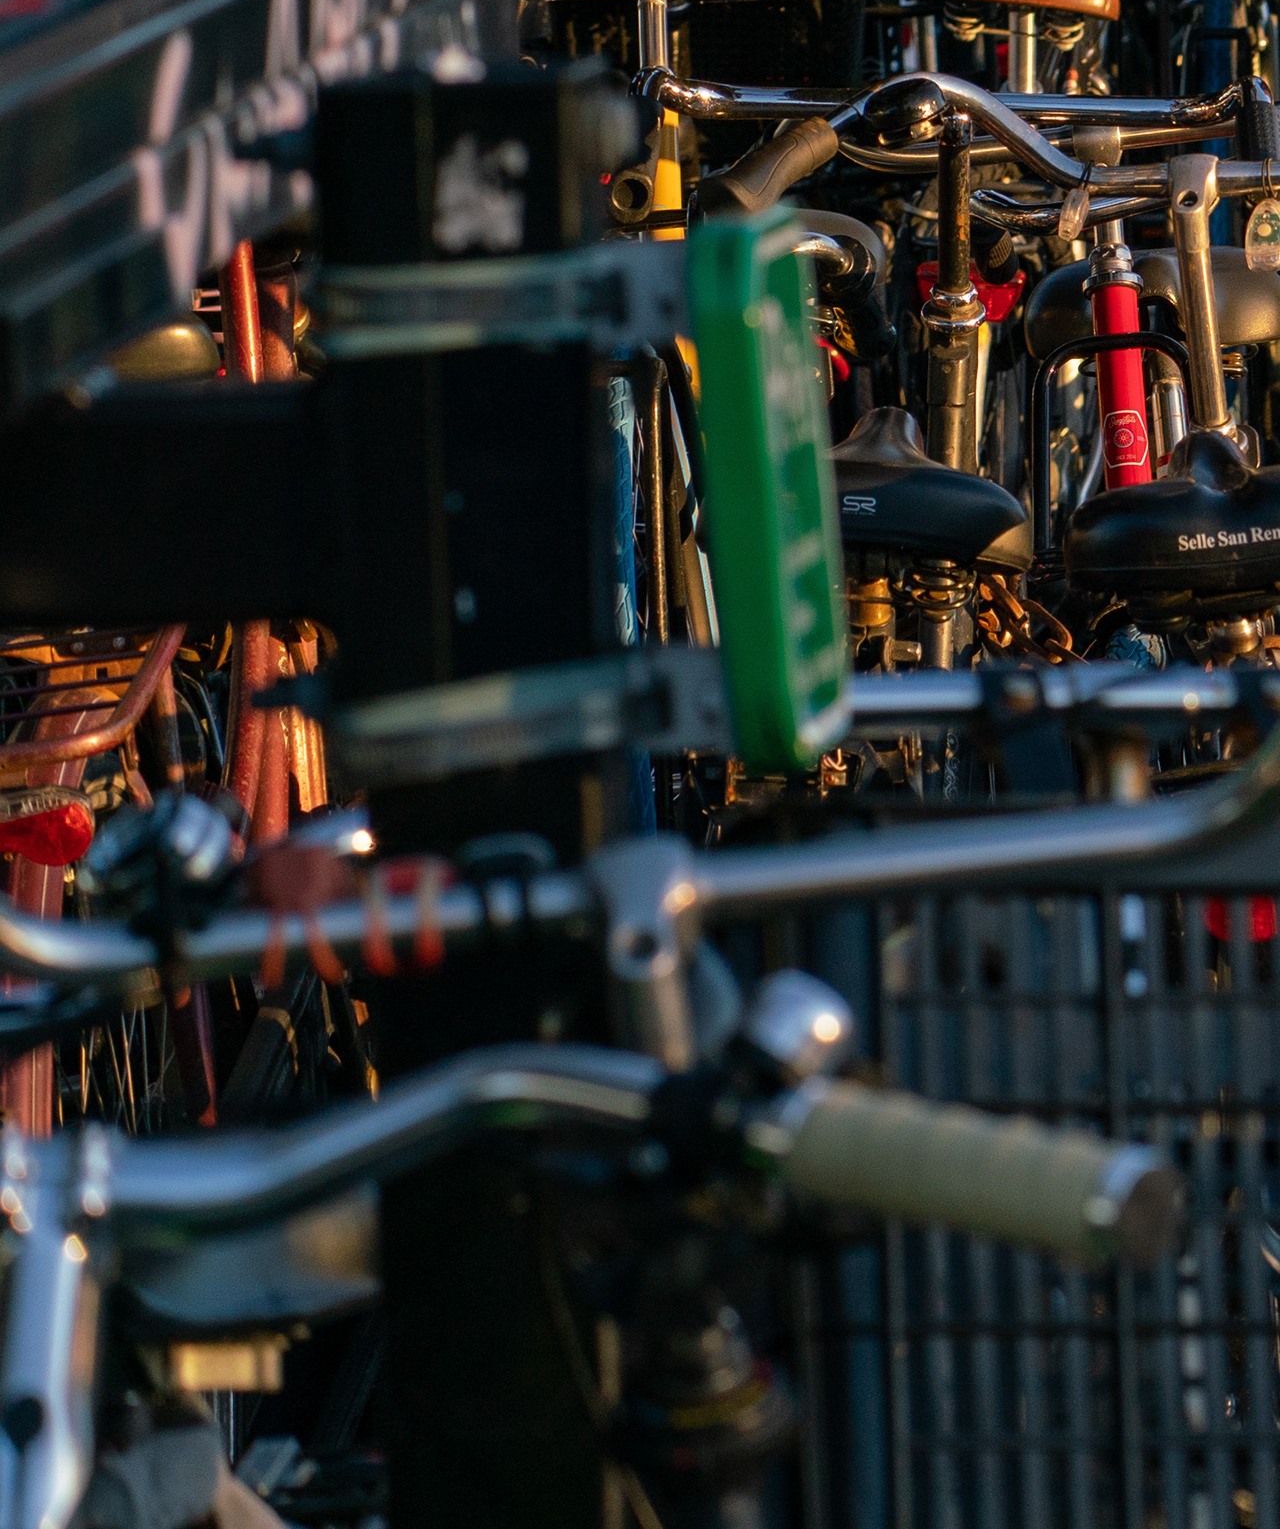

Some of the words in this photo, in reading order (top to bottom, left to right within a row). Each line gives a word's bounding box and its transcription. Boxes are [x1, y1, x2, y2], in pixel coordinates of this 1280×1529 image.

[843, 495, 877, 512] SR
[1178, 533, 1215, 551] Selle
[1217, 530, 1248, 547] San
